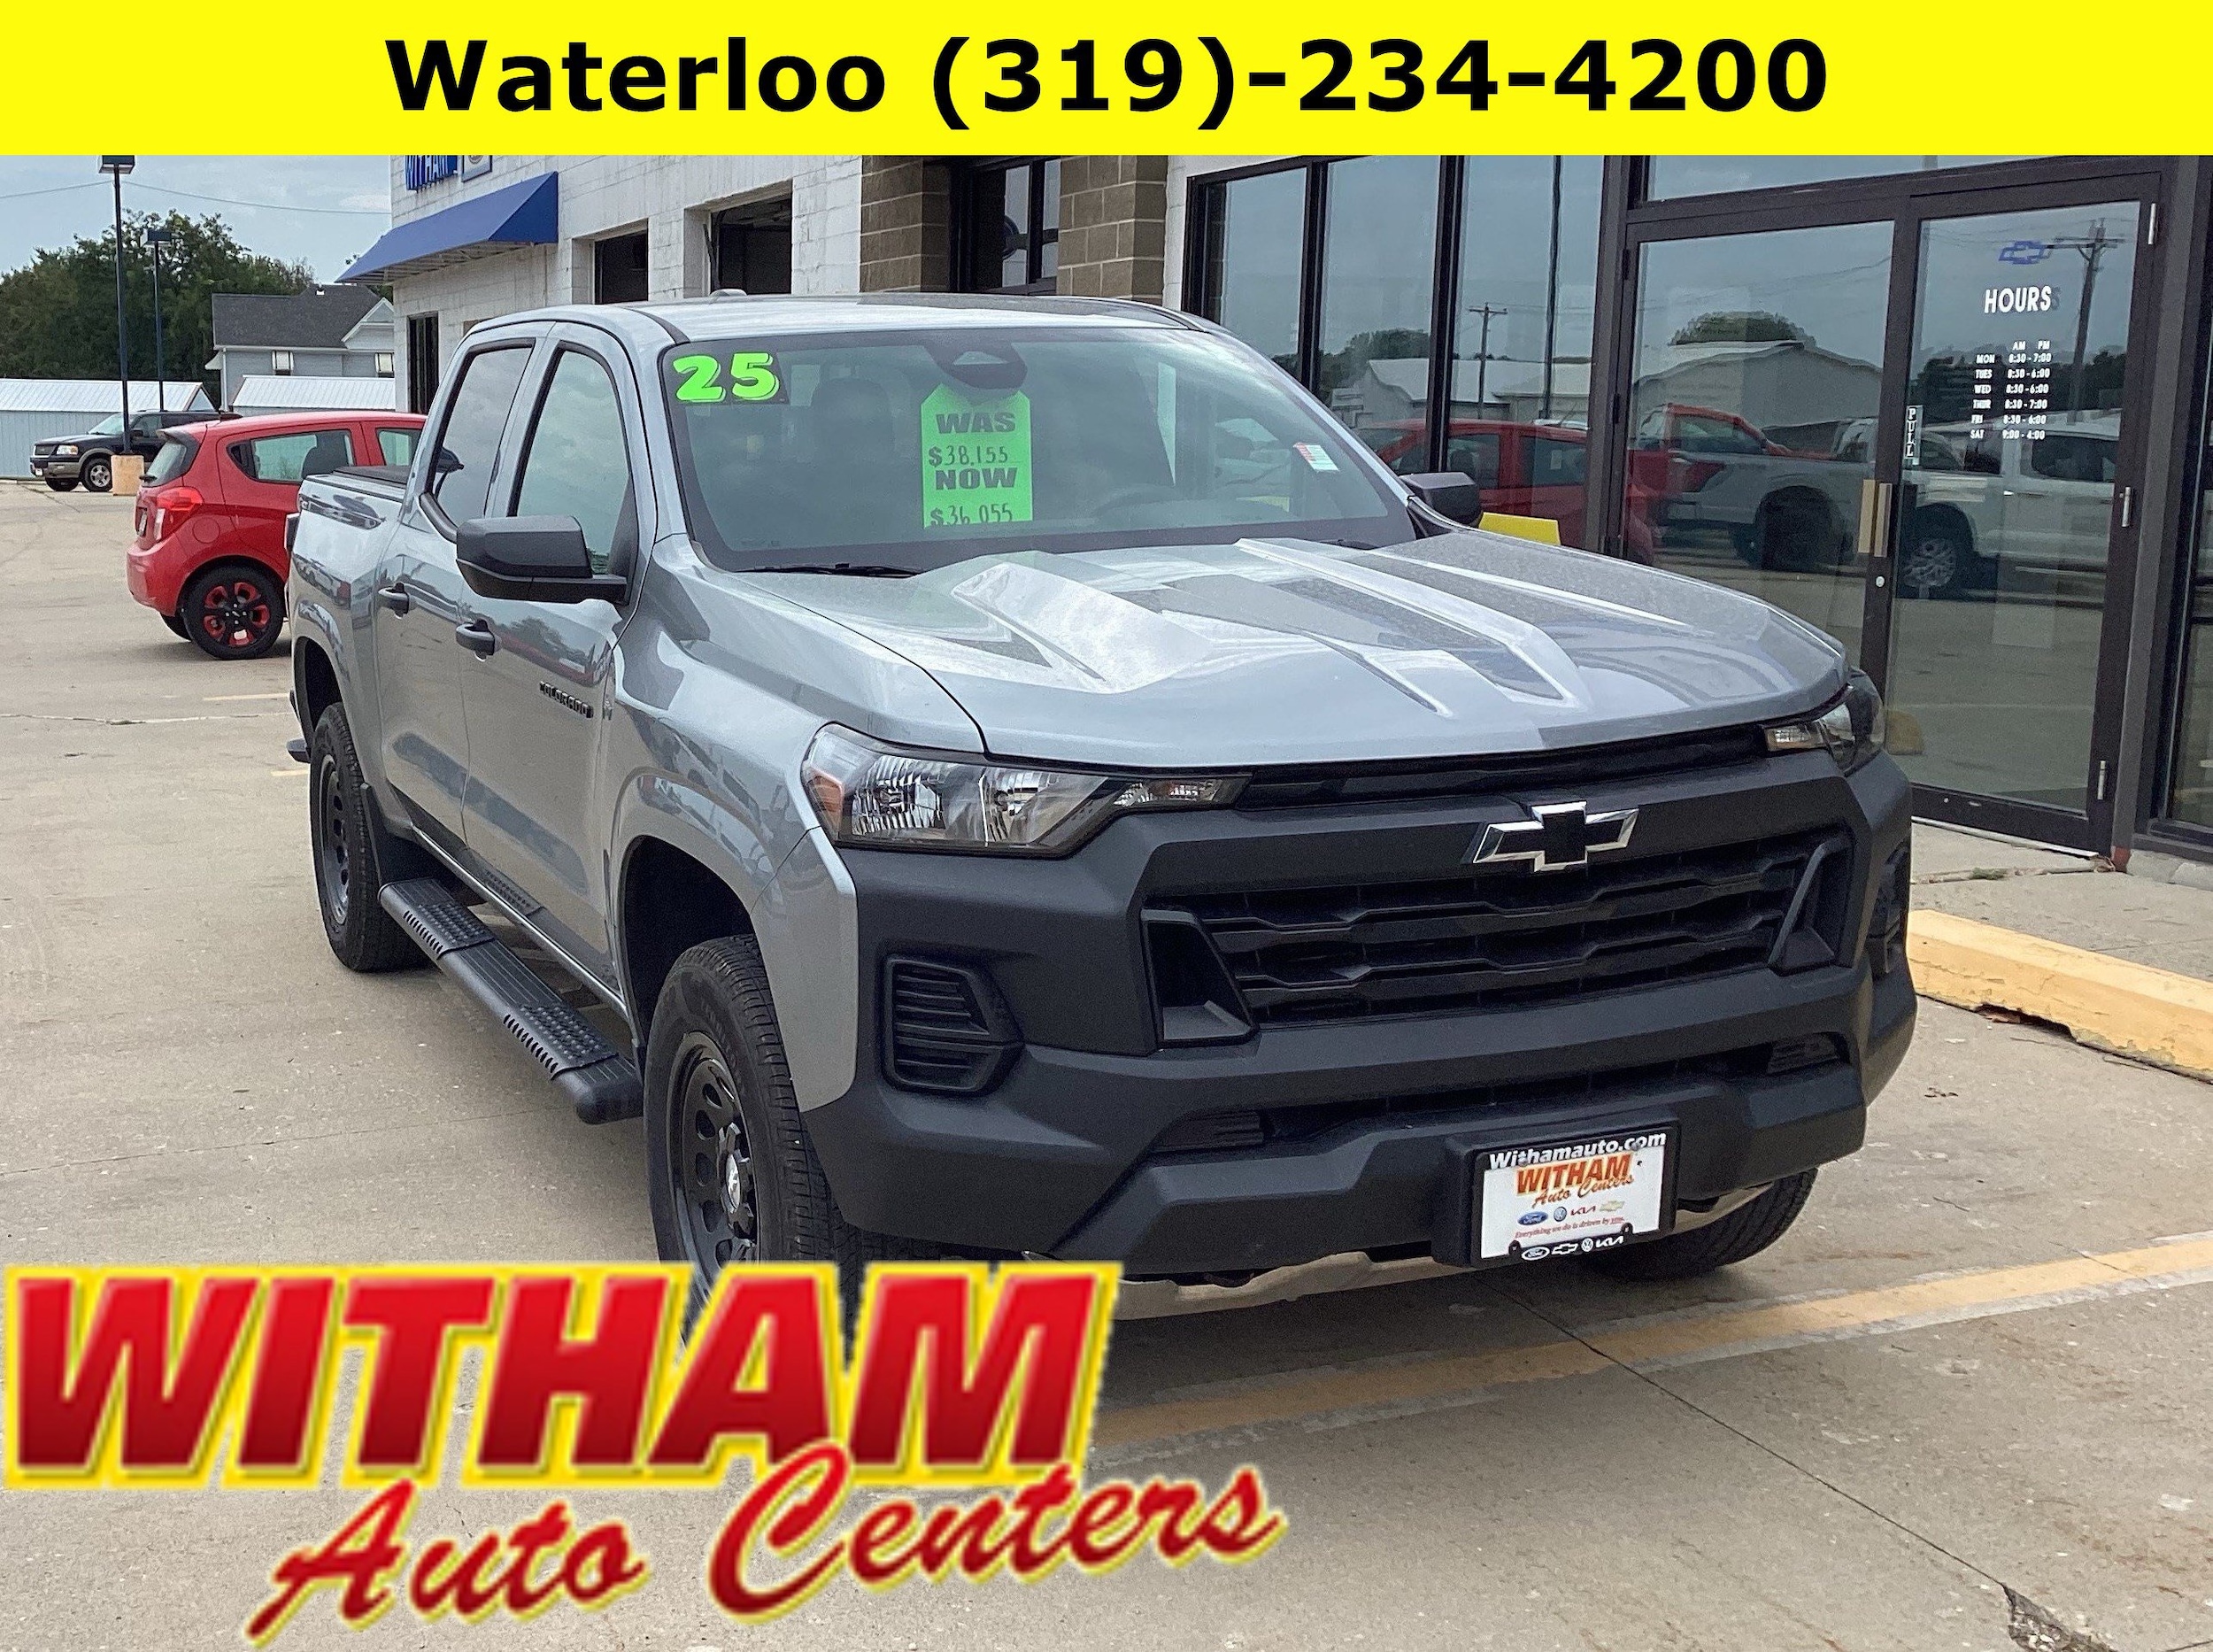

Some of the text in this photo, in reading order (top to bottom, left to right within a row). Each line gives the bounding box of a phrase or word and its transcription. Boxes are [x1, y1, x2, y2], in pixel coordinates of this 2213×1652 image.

[1984, 286, 2052, 313] HOURS
[2012, 340, 2050, 351] AM PM
[1976, 354, 1995, 364] MON
[2033, 352, 2052, 362] 7:00
[672, 352, 780, 404] 25
[1975, 369, 1993, 379] TUES
[2031, 367, 2051, 378] 6:00
[1974, 384, 1992, 394] WED
[2030, 383, 2049, 394] 6:00
[2029, 399, 2048, 409] 7:00
[936, 412, 1016, 435] WAS
[2028, 414, 2047, 424] 6:00
[1906, 407, 1916, 457] PULL
[1970, 429, 1985, 439] SAT
[2026, 429, 2046, 439] 4:00
[935, 467, 1018, 490] NOW
[1490, 1133, 1666, 1170] Withamauto.com
[1516, 1153, 1632, 1195] WITHAM
[1532, 1174, 1635, 1209] Auto Centers
